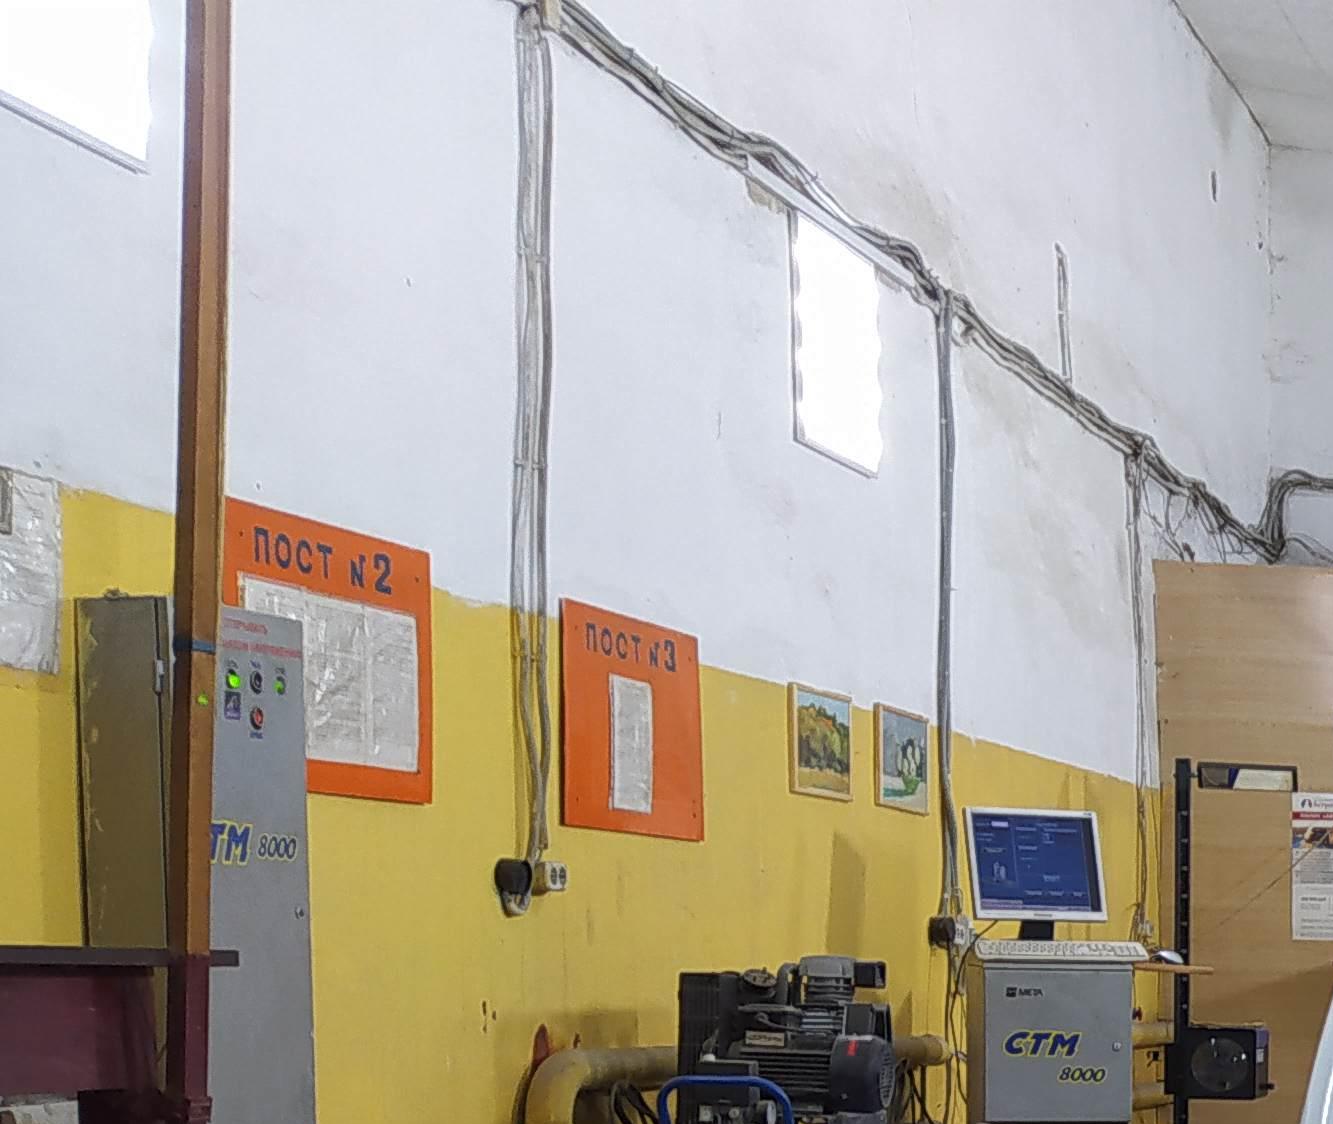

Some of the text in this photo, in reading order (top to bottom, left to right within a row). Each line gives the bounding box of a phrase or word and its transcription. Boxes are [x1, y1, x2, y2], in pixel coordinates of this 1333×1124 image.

[253, 525, 334, 580] ПОСТ
[585, 621, 641, 664] ПОСТ
[256, 832, 298, 861] 8000
[1003, 1029, 1081, 1057] СТМ
[1057, 1066, 1106, 1083] 8000
